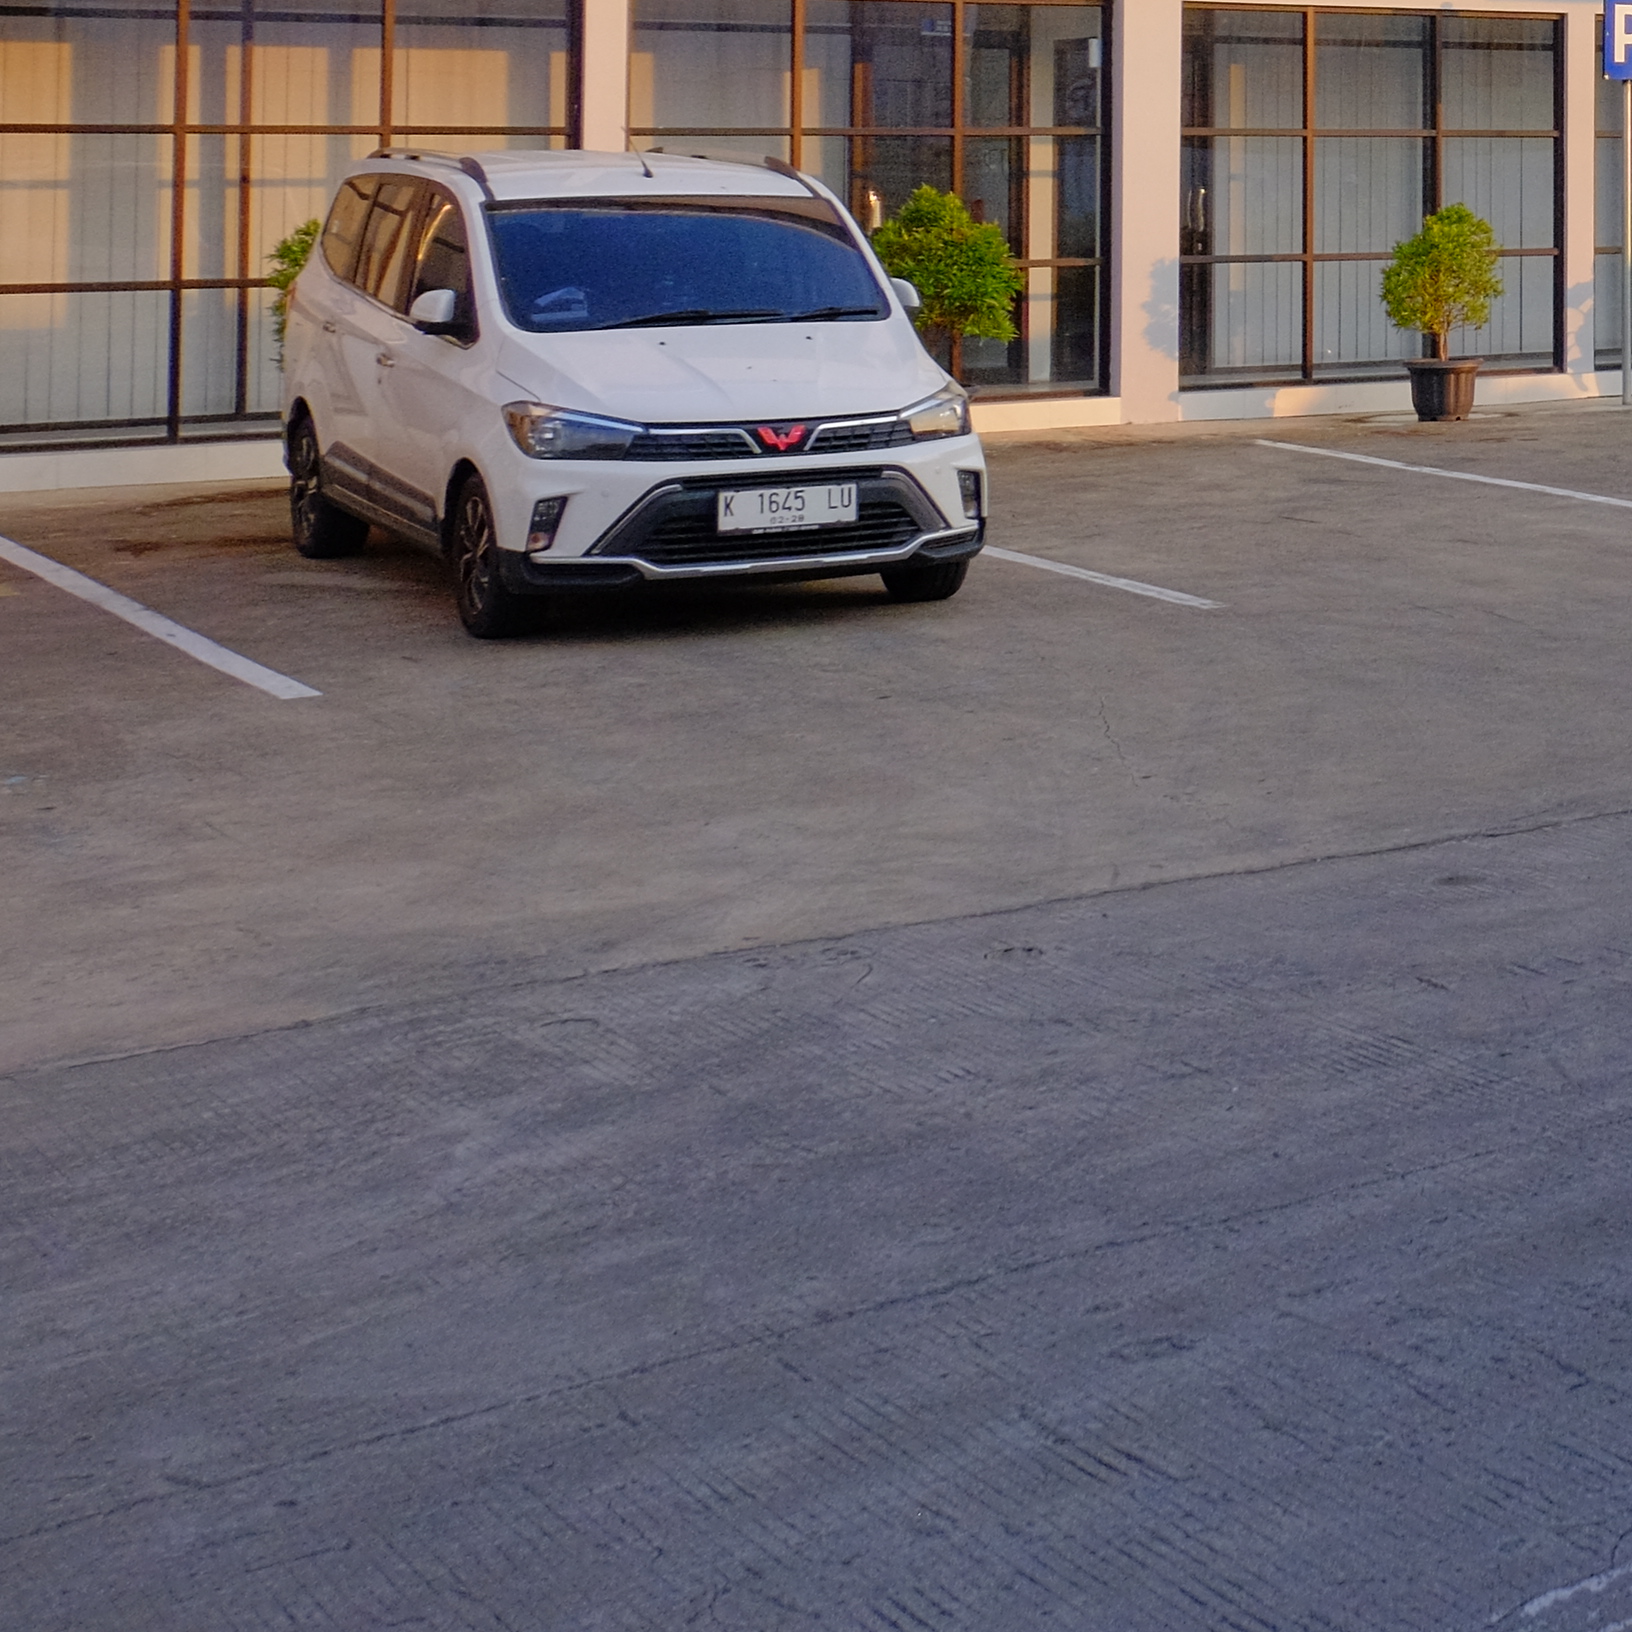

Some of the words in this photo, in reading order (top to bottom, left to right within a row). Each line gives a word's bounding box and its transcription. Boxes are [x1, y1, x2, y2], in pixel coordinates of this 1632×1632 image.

[723, 494, 736, 518] K
[757, 489, 806, 515] 1645
[827, 486, 853, 510] LU
